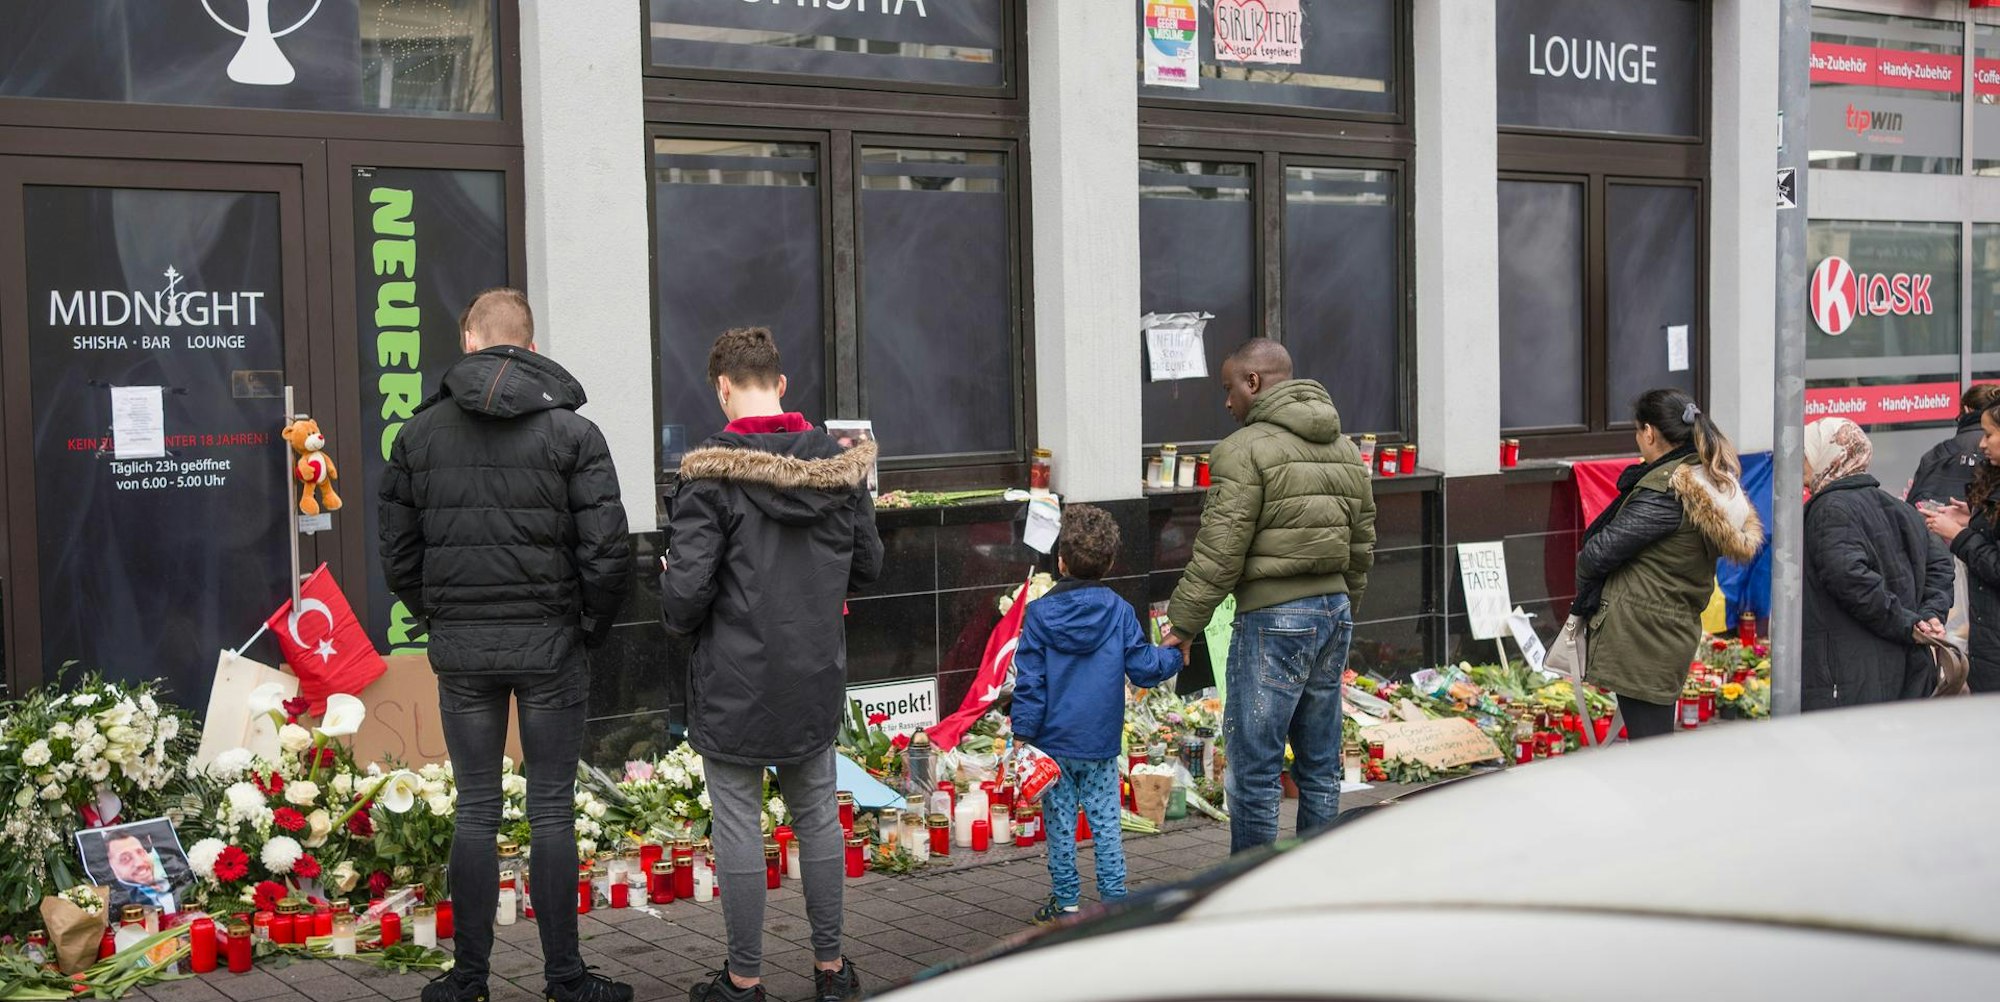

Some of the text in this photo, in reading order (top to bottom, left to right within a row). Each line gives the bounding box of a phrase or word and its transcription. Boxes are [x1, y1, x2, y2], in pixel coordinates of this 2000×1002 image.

[1529, 33, 1658, 85] LOUNGE
[1809, 55, 1867, 73] sha-Zubehör
[1847, 103, 1903, 137] tipwin
[1812, 257, 1933, 334] KIOSK
[73, 335, 246, 350] SHISHA BAR LOUNGE
[1805, 398, 1867, 414] isha-Zubehör
[67, 438, 97, 451] KEIN
[164, 434, 197, 448] NTER
[200, 434, 213, 446] 18
[216, 433, 263, 446] JAHREN
[110, 458, 231, 477] Täglich 23h geöffnet
[116, 479, 139, 490] von
[142, 476, 167, 489] 6.00
[177, 475, 201, 488] 5.00
[204, 474, 226, 486] Uhr
